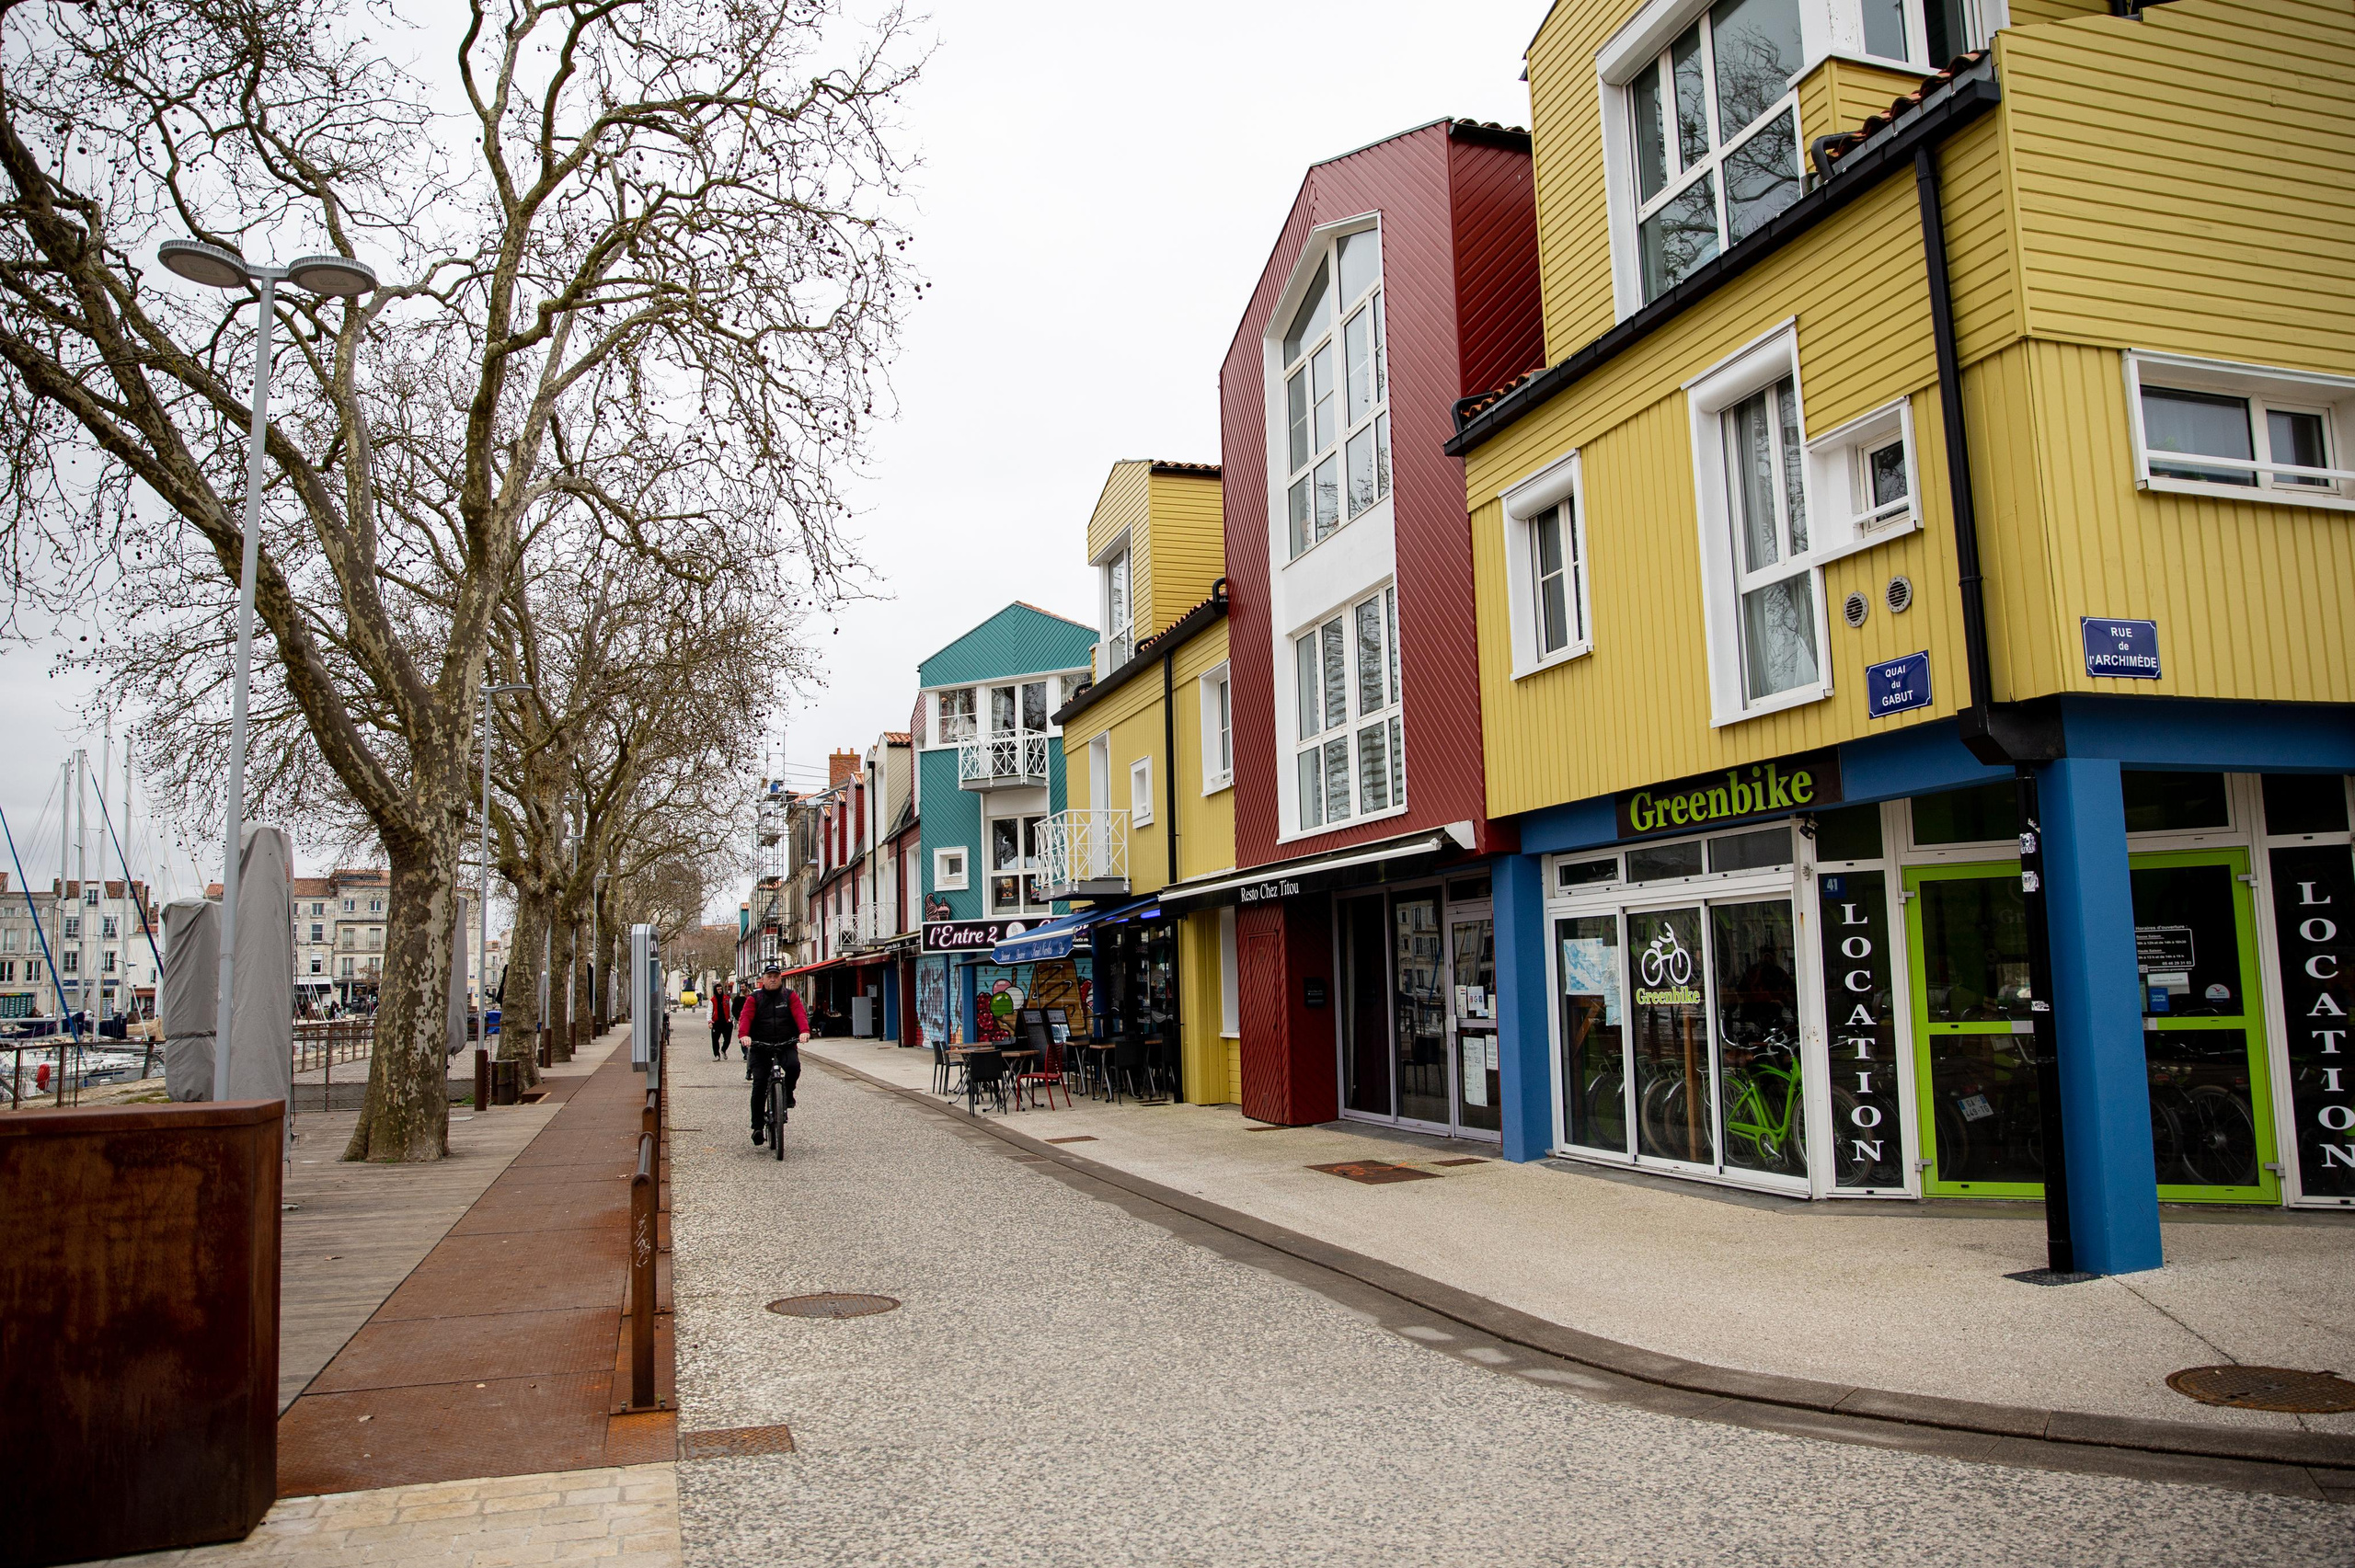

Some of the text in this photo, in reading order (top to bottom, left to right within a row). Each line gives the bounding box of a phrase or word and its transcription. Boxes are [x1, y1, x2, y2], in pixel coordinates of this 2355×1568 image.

[2109, 626, 2133, 638] RUE
[2118, 641, 2130, 651] de
[2089, 651, 2158, 669] l'ARCHIMÈDE
[1884, 664, 1907, 679] QUAI
[1890, 680, 1901, 690] du
[1881, 689, 1914, 707] GABUT
[1629, 762, 1815, 831] Greenbike
[1240, 879, 1299, 902] Resto Chez Titou
[1826, 878, 1838, 891] 41
[929, 925, 983, 947] l'Entre
[987, 925, 998, 943] 2
[1636, 986, 1701, 1005] Greenbike
[1841, 903, 1884, 1162] LOCATION
[2297, 881, 2355, 1168] LOCATION
